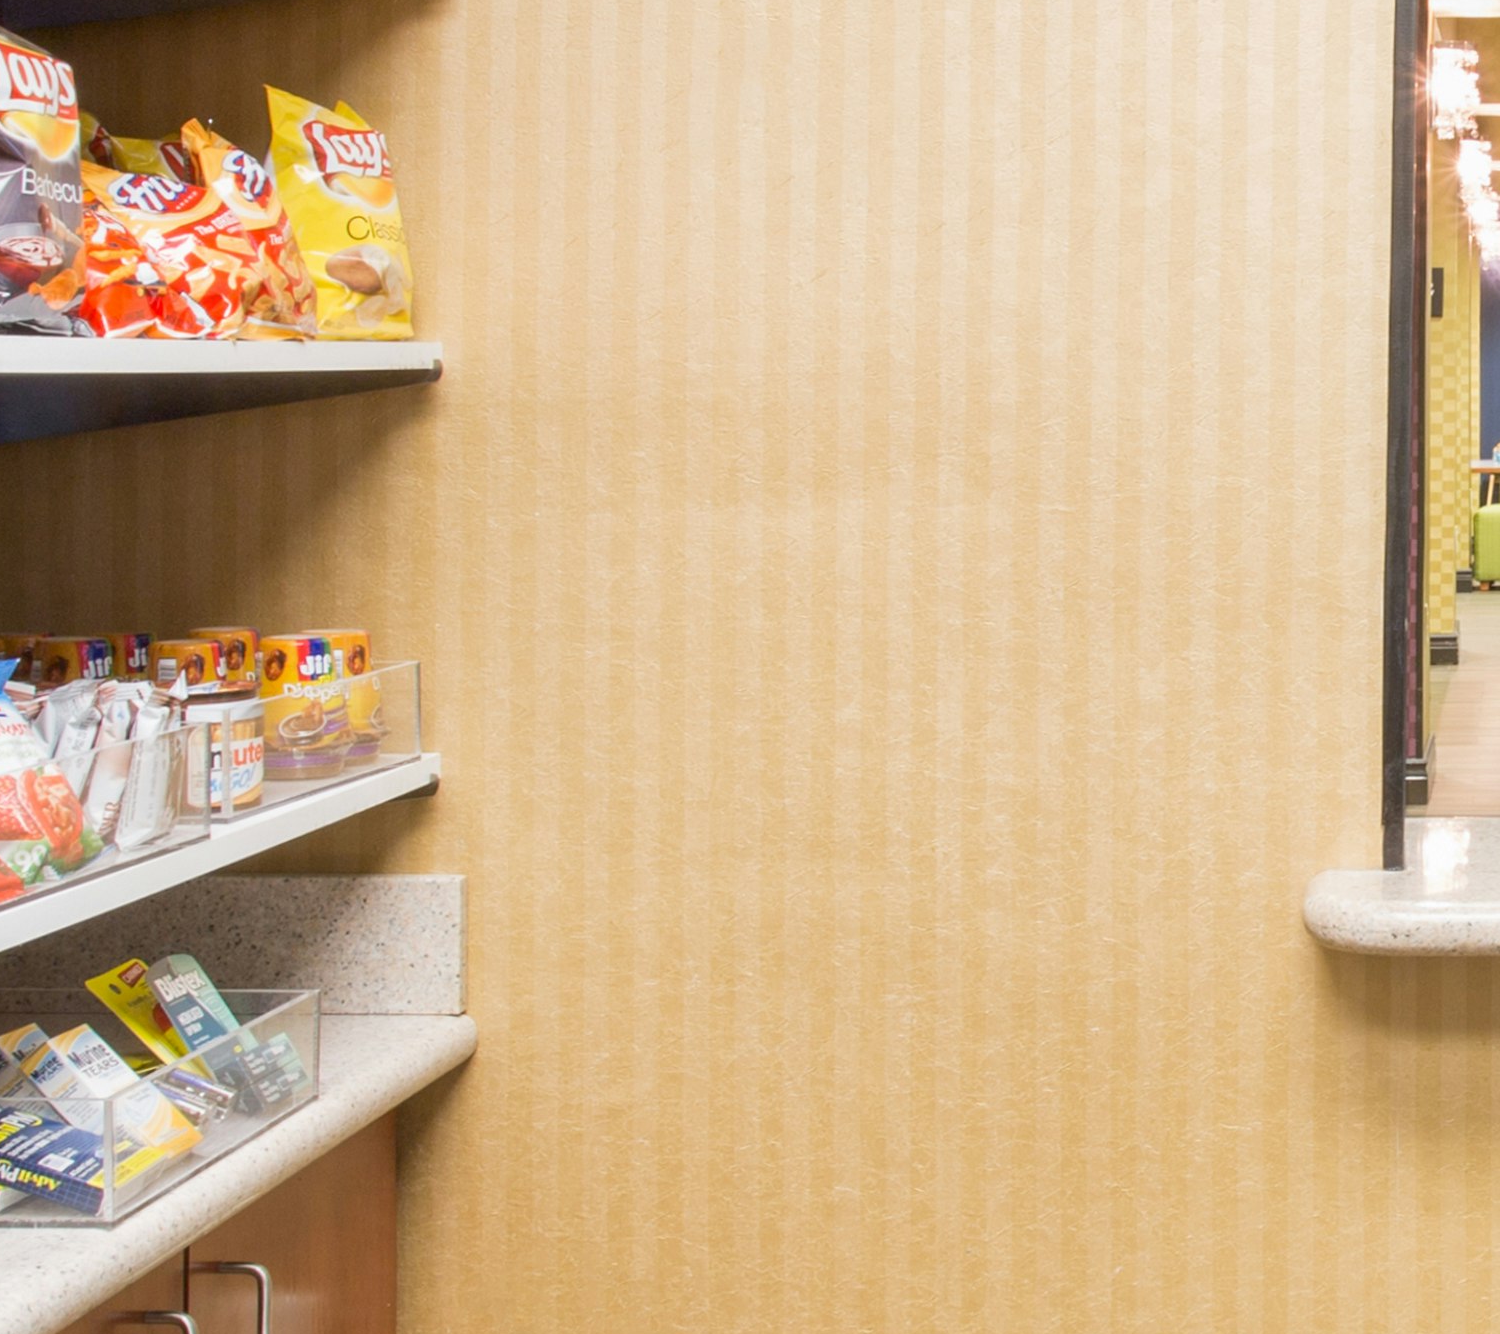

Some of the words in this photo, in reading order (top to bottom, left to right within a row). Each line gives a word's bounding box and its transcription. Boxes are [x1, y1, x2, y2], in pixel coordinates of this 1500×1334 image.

[83, 658, 113, 679] Jif
[300, 654, 331, 676] Jif
[153, 970, 207, 1002] Blistex
[67, 1043, 111, 1068] Murine
[82, 1056, 120, 1078] TEARS
[16, 1170, 62, 1191] Advil
